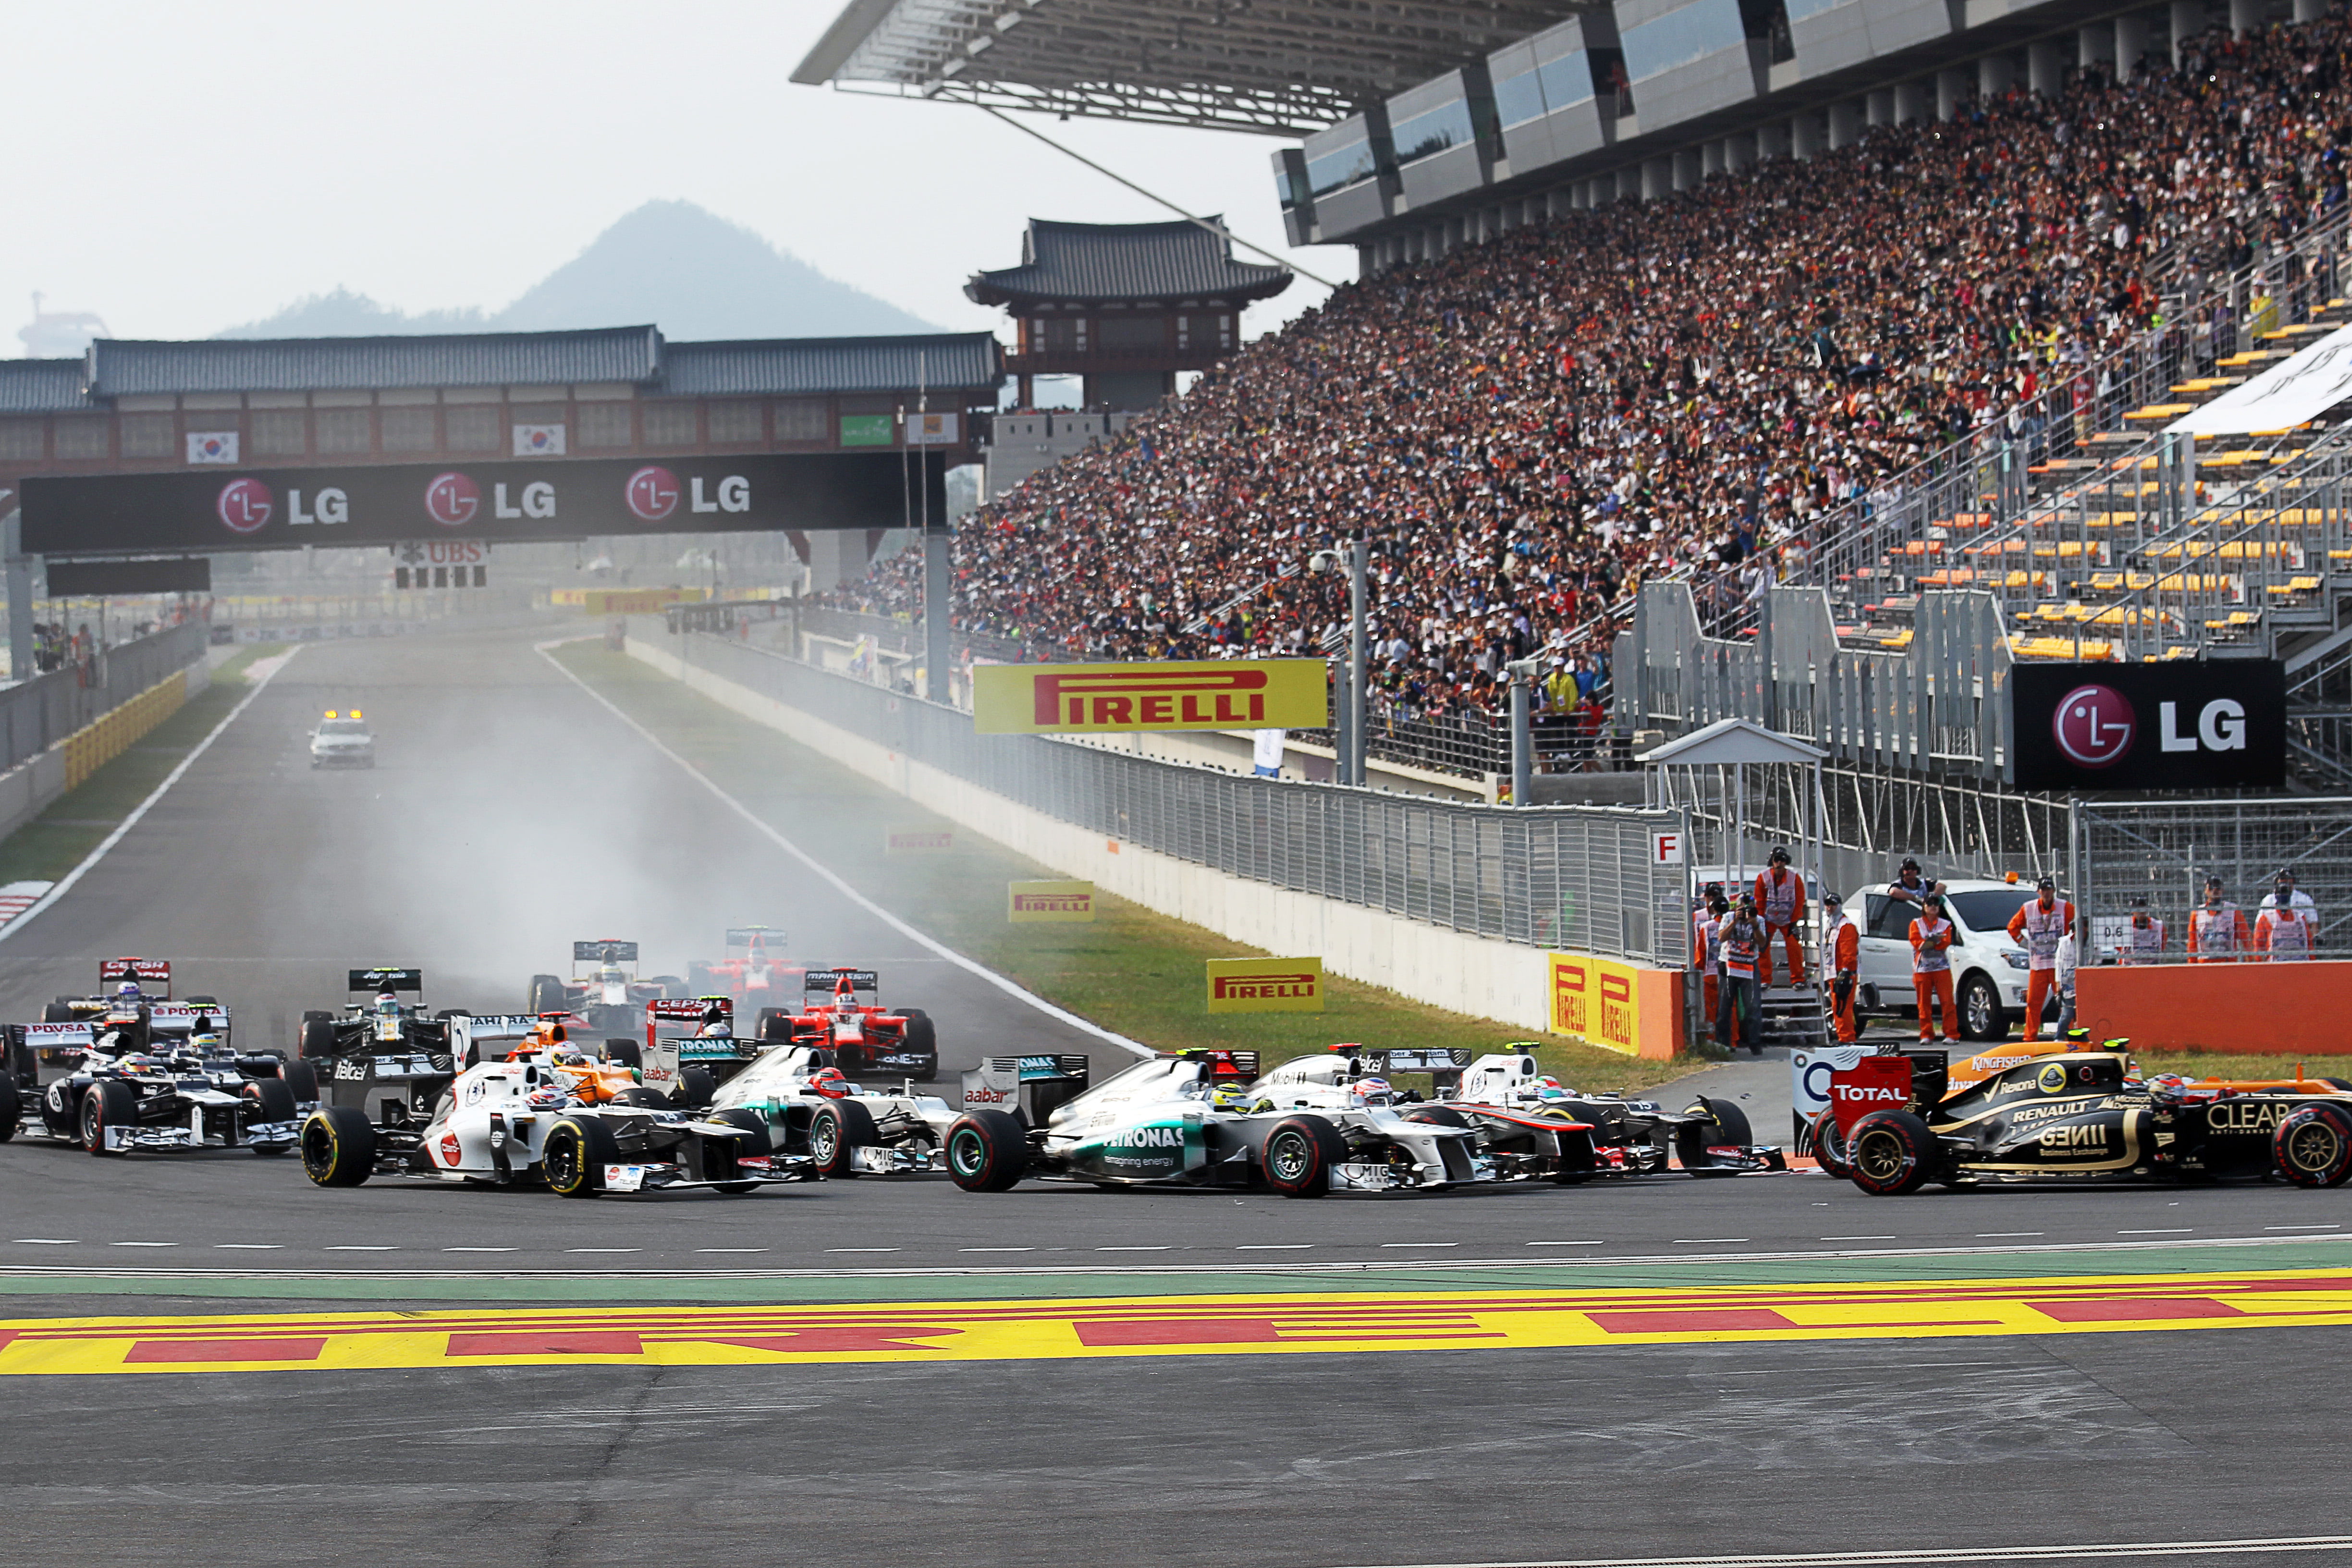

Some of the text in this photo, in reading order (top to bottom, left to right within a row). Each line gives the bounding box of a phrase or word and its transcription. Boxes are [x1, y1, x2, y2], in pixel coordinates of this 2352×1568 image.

[495, 482, 556, 518] LG
[691, 476, 750, 513] LG
[289, 487, 348, 524] LG
[428, 541, 481, 564] UBS
[1034, 670, 1268, 725] PIRELLI
[2160, 698, 2246, 752] LG
[1660, 836, 1676, 860] F
[1014, 894, 1090, 912] PIRELLI
[1214, 974, 1315, 999] PIRELLI
[1556, 965, 1585, 1032] PIRELLI
[1601, 973, 1631, 1045] PIRELLI
[33, 1024, 87, 1033] PDVSA
[334, 1061, 368, 1081] telcel
[644, 1066, 672, 1081] aabar
[965, 1087, 1009, 1103] aabar
[1834, 1085, 1909, 1101] TOTAL
[2000, 1079, 2036, 1095] Rexona
[50, 1090, 61, 1107] 18
[2012, 1101, 2090, 1123] RENAULT
[2208, 1103, 2290, 1129] CLEAR
[1103, 1127, 1185, 1148] PETRONAS
[875, 1149, 893, 1160] MIG
[1143, 1157, 1174, 1167] energy
[1362, 1165, 1388, 1177] MIG
